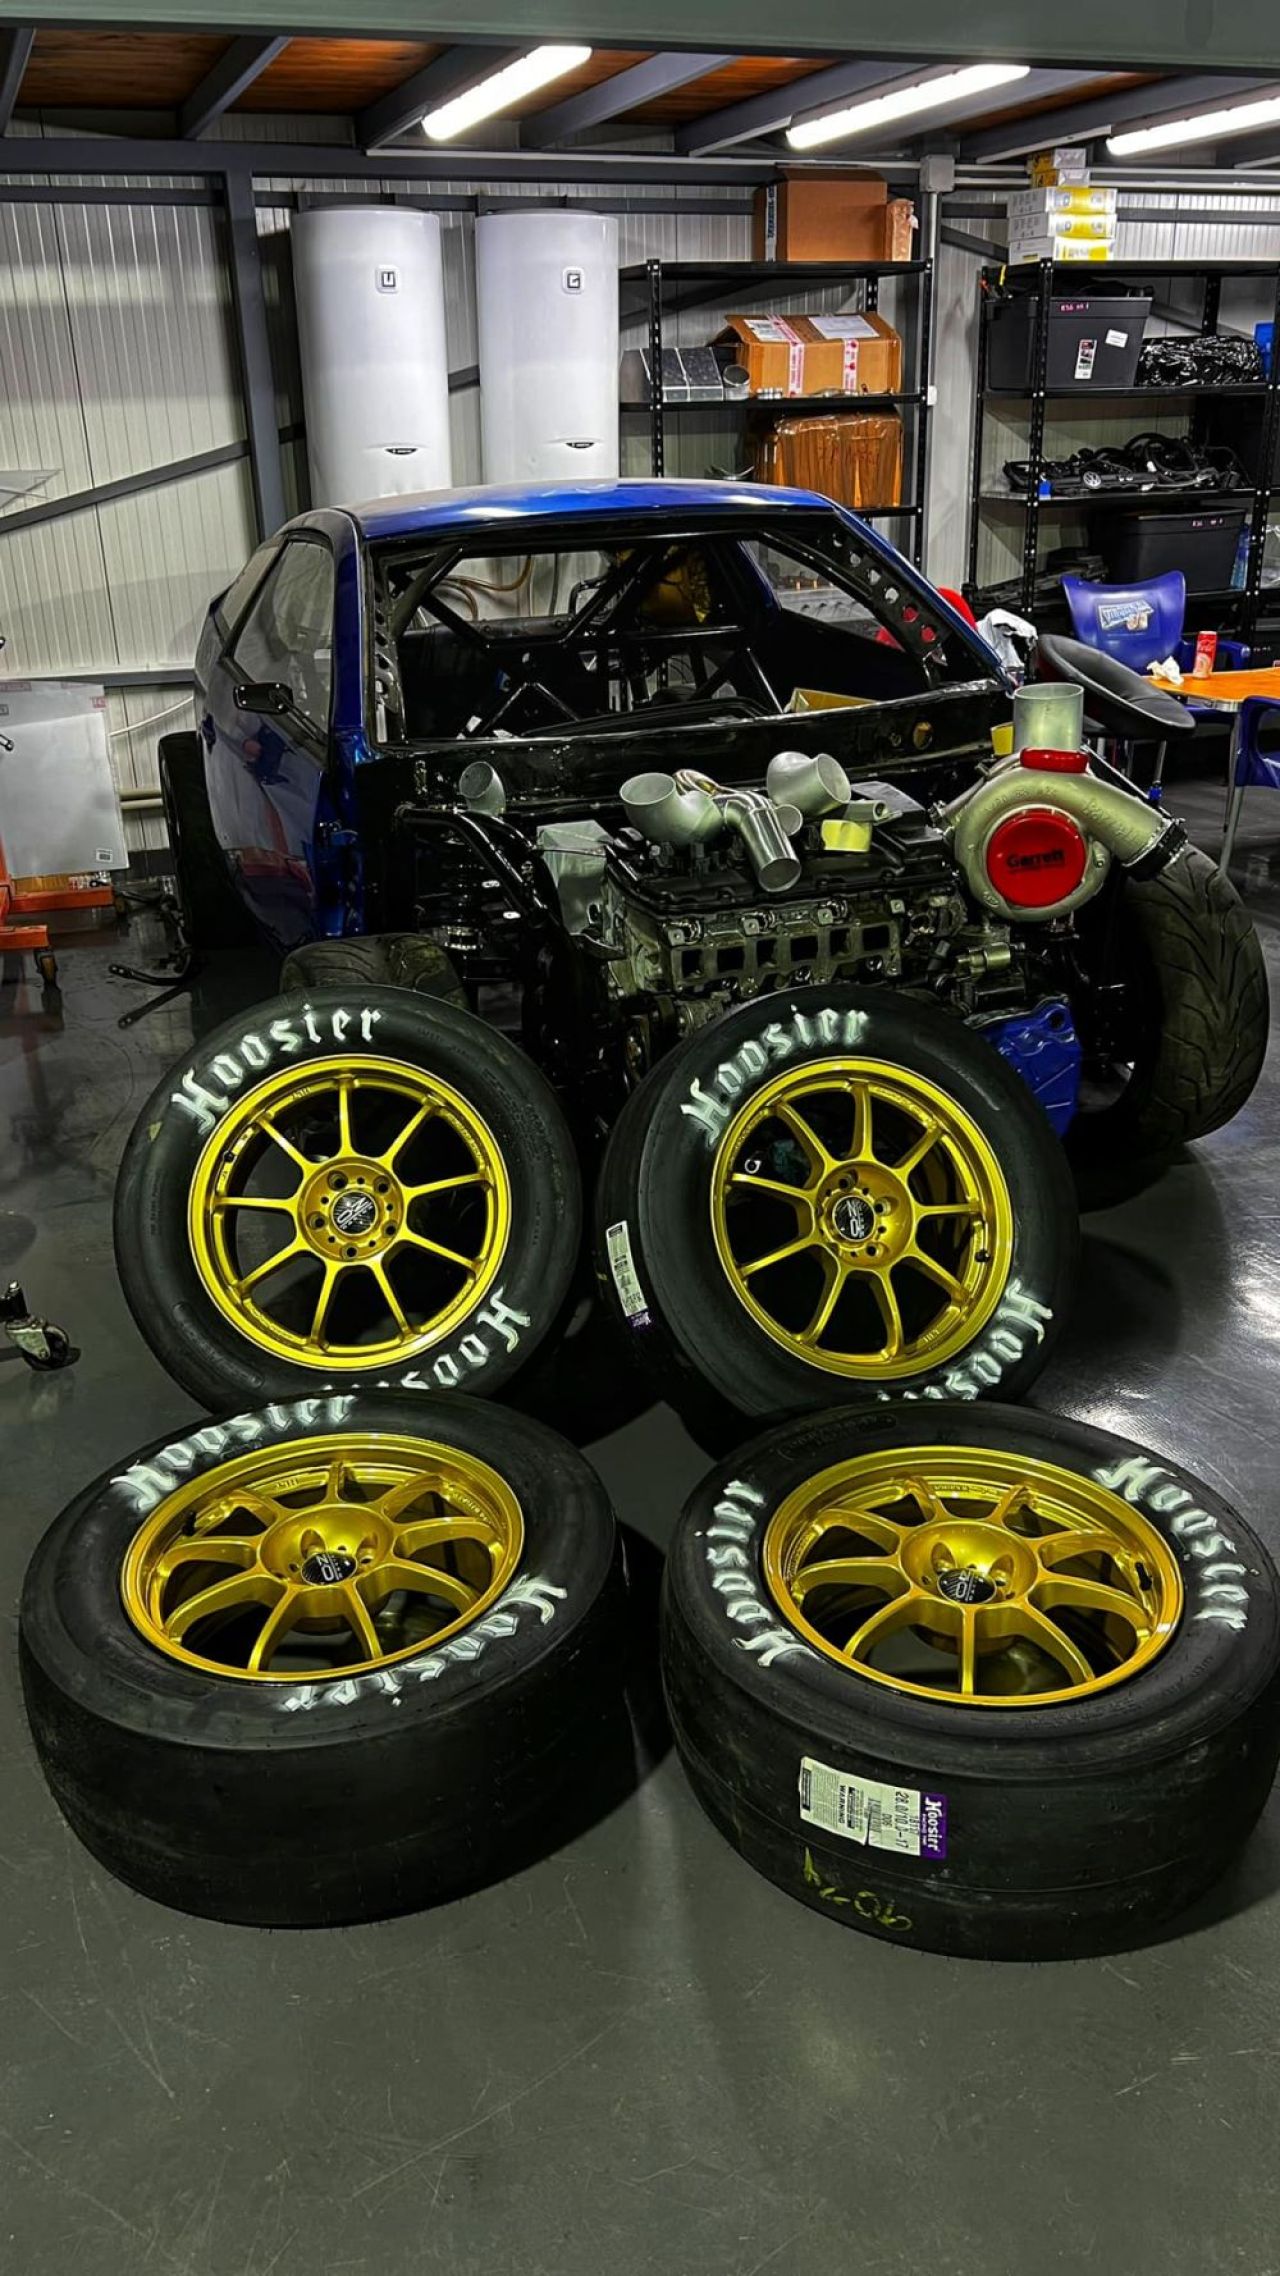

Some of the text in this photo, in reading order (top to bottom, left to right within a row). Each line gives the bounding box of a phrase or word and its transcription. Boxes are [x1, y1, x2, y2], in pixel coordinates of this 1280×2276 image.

[1006, 849, 1065, 869] Garrett
[171, 1003, 383, 1135] Hoosier
[680, 1003, 870, 1145] Hoosier
[322, 1286, 532, 1390] Hoos
[109, 1395, 357, 1511] Hoosier
[694, 1479, 826, 1668] Hoosier
[1093, 1455, 1260, 1629] Hoosier
[281, 1574, 568, 1711] Hoosier
[838, 1784, 847, 1825] WARNING
[924, 1796, 943, 1852] Hoosier
